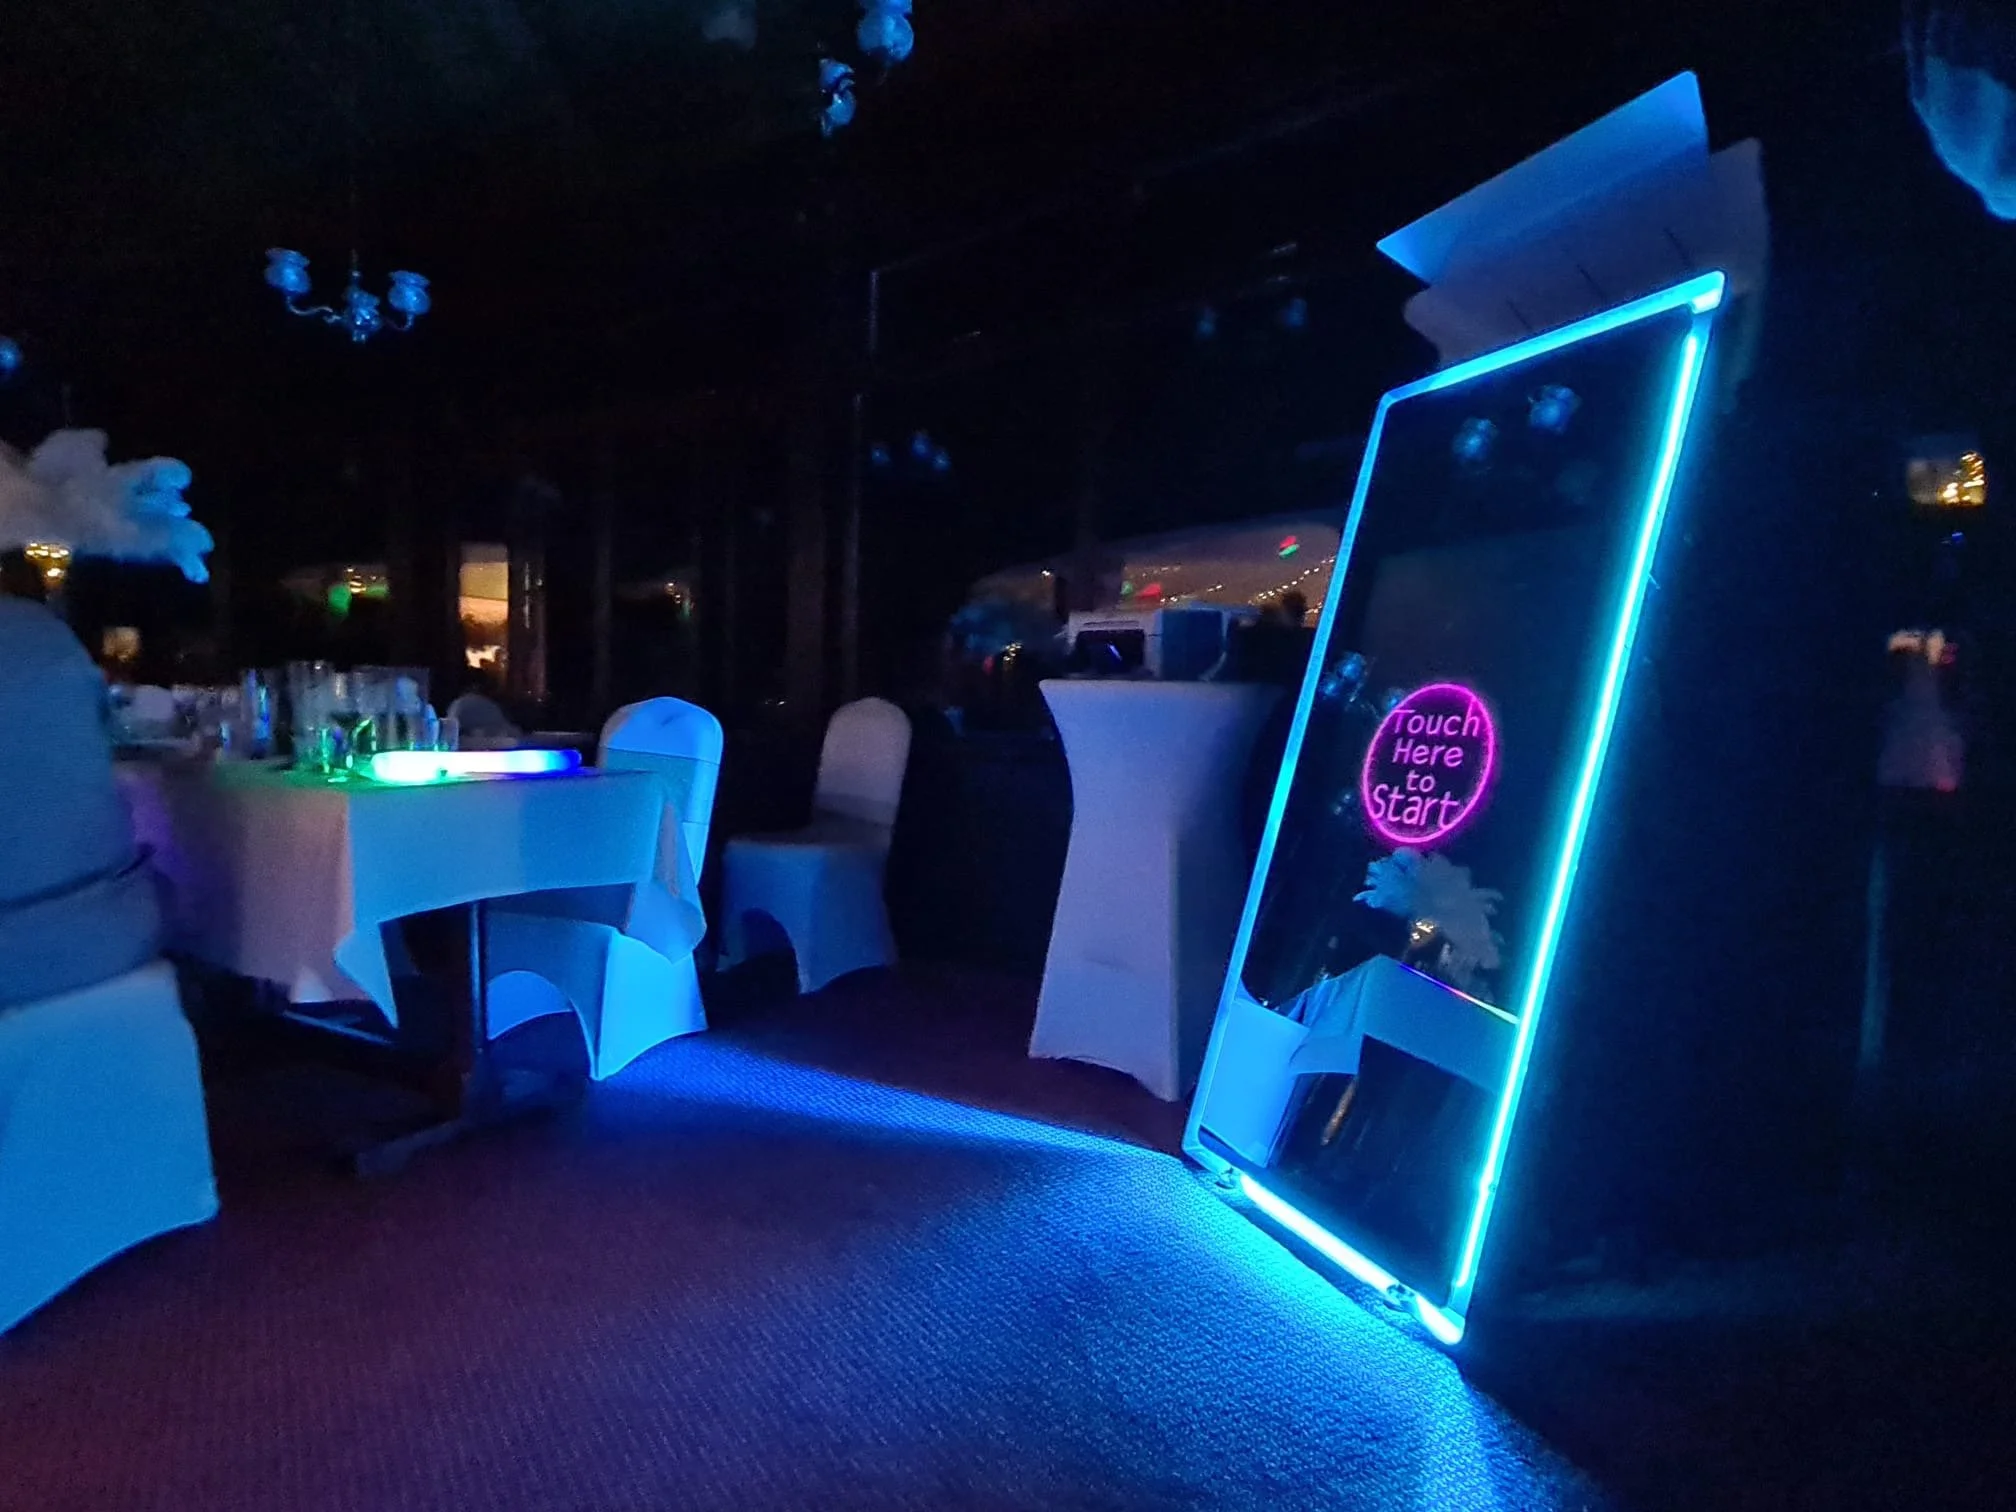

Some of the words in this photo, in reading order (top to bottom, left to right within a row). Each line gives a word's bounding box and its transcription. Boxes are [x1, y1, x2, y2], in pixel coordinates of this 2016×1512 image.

[1391, 695, 1480, 737] Touch
[1392, 737, 1464, 768] Here
[1406, 769, 1436, 793] to
[1373, 783, 1460, 828] Start
